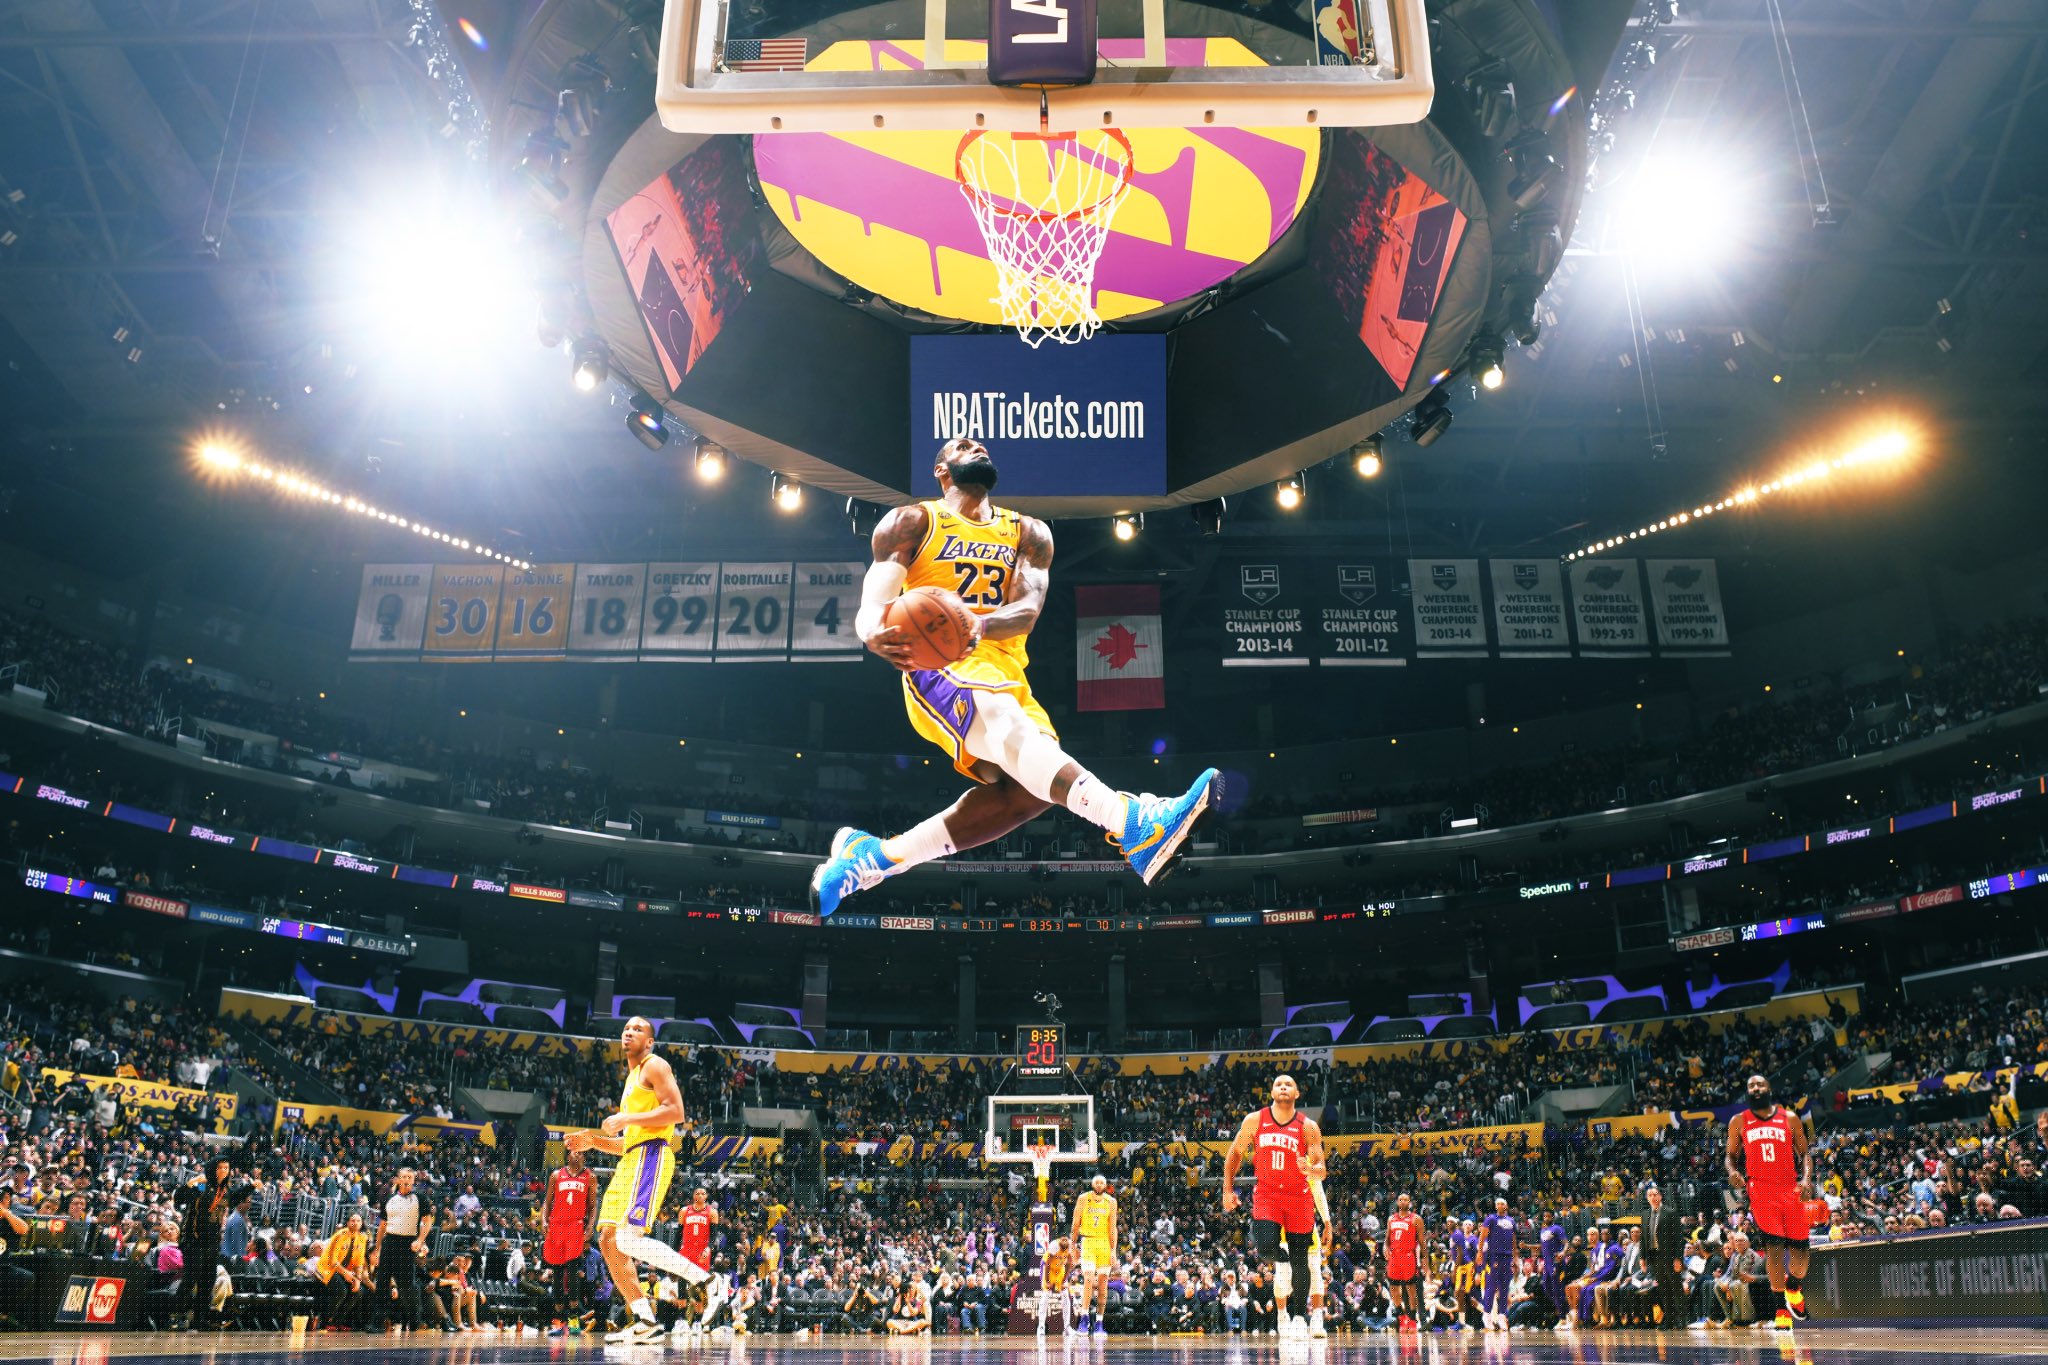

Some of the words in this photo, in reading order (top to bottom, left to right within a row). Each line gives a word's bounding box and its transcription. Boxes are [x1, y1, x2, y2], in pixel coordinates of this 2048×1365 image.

[1324, 54, 1345, 66] NBA
[933, 392, 1144, 439] NBATickets.com
[934, 535, 1017, 568] LAKERS
[1244, 569, 1276, 582] LA
[1342, 569, 1371, 582] LA
[1433, 567, 1455, 577] LA
[1514, 566, 1537, 577] LA
[372, 575, 420, 586] MILLER
[442, 575, 493, 586] VACHON
[587, 574, 633, 586] TAYLOR
[652, 573, 711, 585] GRETZKY
[723, 573, 788, 585] ROBITAILLE
[809, 573, 852, 585] BLAKE
[955, 562, 1006, 606] 23
[1423, 594, 1469, 603] WESTERN
[1504, 594, 1551, 603] WESTERN
[1583, 594, 1632, 603] CAMPBELL
[1668, 594, 1705, 603] SMYTHE
[1224, 609, 1273, 619] STANLEY
[1277, 608, 1301, 619] CUP
[1322, 609, 1370, 619] STANLEY
[1374, 609, 1397, 619] CUP
[1417, 604, 1478, 614] CONFERENCE
[1499, 604, 1560, 614] CONFERENCE
[1578, 604, 1640, 614] CONFERENCE
[1667, 604, 1709, 613] DIVISION
[435, 597, 489, 636] 30
[513, 597, 554, 636] 16
[584, 598, 626, 635] 18
[652, 596, 707, 635] 99
[725, 597, 781, 635] 20
[815, 597, 840, 634] 4
[1421, 615, 1476, 625] CHAMPIONS
[1504, 615, 1559, 624] CHAMPIONS
[1583, 615, 1638, 624] CHAMPIONS
[1662, 615, 1717, 624] CHAMPIONS
[1225, 621, 1302, 633] CHAMPIONS
[1323, 621, 1399, 633] CHAMPIONS
[1671, 628, 1714, 638] 1990-91
[1429, 628, 1471, 639] 2013-14
[1514, 628, 1553, 639] 2011-12
[1590, 628, 1634, 639] 1992-93
[1236, 638, 1293, 652] 2013-14
[1335, 638, 1389, 652] 2011-12
[36, 788, 90, 809] SPORTSNET
[1972, 789, 2022, 810] SPORTSNET
[721, 814, 740, 822] BUD
[740, 816, 766, 825] LIGHT
[190, 828, 235, 844] SPORTSNET
[1827, 828, 1871, 844] SPORTSNET
[334, 858, 379, 873] SPORTSNET
[993, 864, 1005, 872] TEXT
[1070, 864, 1092, 872] LOCATION
[1093, 864, 1099, 872] TO
[1100, 864, 1125, 872] 69050
[1684, 858, 1728, 874] SPORTSNET
[28, 868, 48, 881] NSH
[67, 877, 73, 886] 3
[1969, 879, 1989, 891] NSH
[2007, 873, 2013, 881] 3
[64, 886, 70, 895] 2
[1520, 881, 1571, 898] Spectrum
[1580, 881, 1589, 890] ET
[2009, 882, 2015, 890] 2
[93, 891, 112, 903] NHL
[513, 886, 538, 896] WELLS
[539, 889, 563, 899] FARGO
[126, 892, 186, 917] TOSHIBA
[1379, 902, 1395, 910] HOU
[729, 907, 742, 915] LAL
[745, 908, 761, 916] HOU
[1264, 911, 1314, 923] TOSHIBA
[1381, 909, 1389, 917] 21
[200, 911, 219, 922] BUD
[219, 913, 244, 926] LIGHT
[263, 917, 281, 927] CAR
[839, 918, 876, 926] DELTA
[882, 917, 932, 929] STAPLES
[1096, 920, 1109, 930] 70
[1741, 924, 1758, 934] CAR
[1807, 920, 1826, 931] NHL
[327, 935, 344, 945] NHL
[368, 938, 409, 953] DELTA
[1678, 931, 1732, 950] STAPLES
[1031, 1030, 1058, 1042] 8:35
[1026, 1043, 1055, 1065] 20
[1031, 1067, 1061, 1075] TISSOT
[1760, 1143, 1776, 1162] 13
[1271, 1151, 1285, 1171] 10
[566, 1192, 573, 1205] 4
[1880, 1260, 1931, 1298] HOUSE
[1934, 1259, 1954, 1296] OF
[1960, 1253, 2048, 1296] HIGHLIGH
[62, 1284, 88, 1312] NBA
[93, 1296, 115, 1310] TNT
